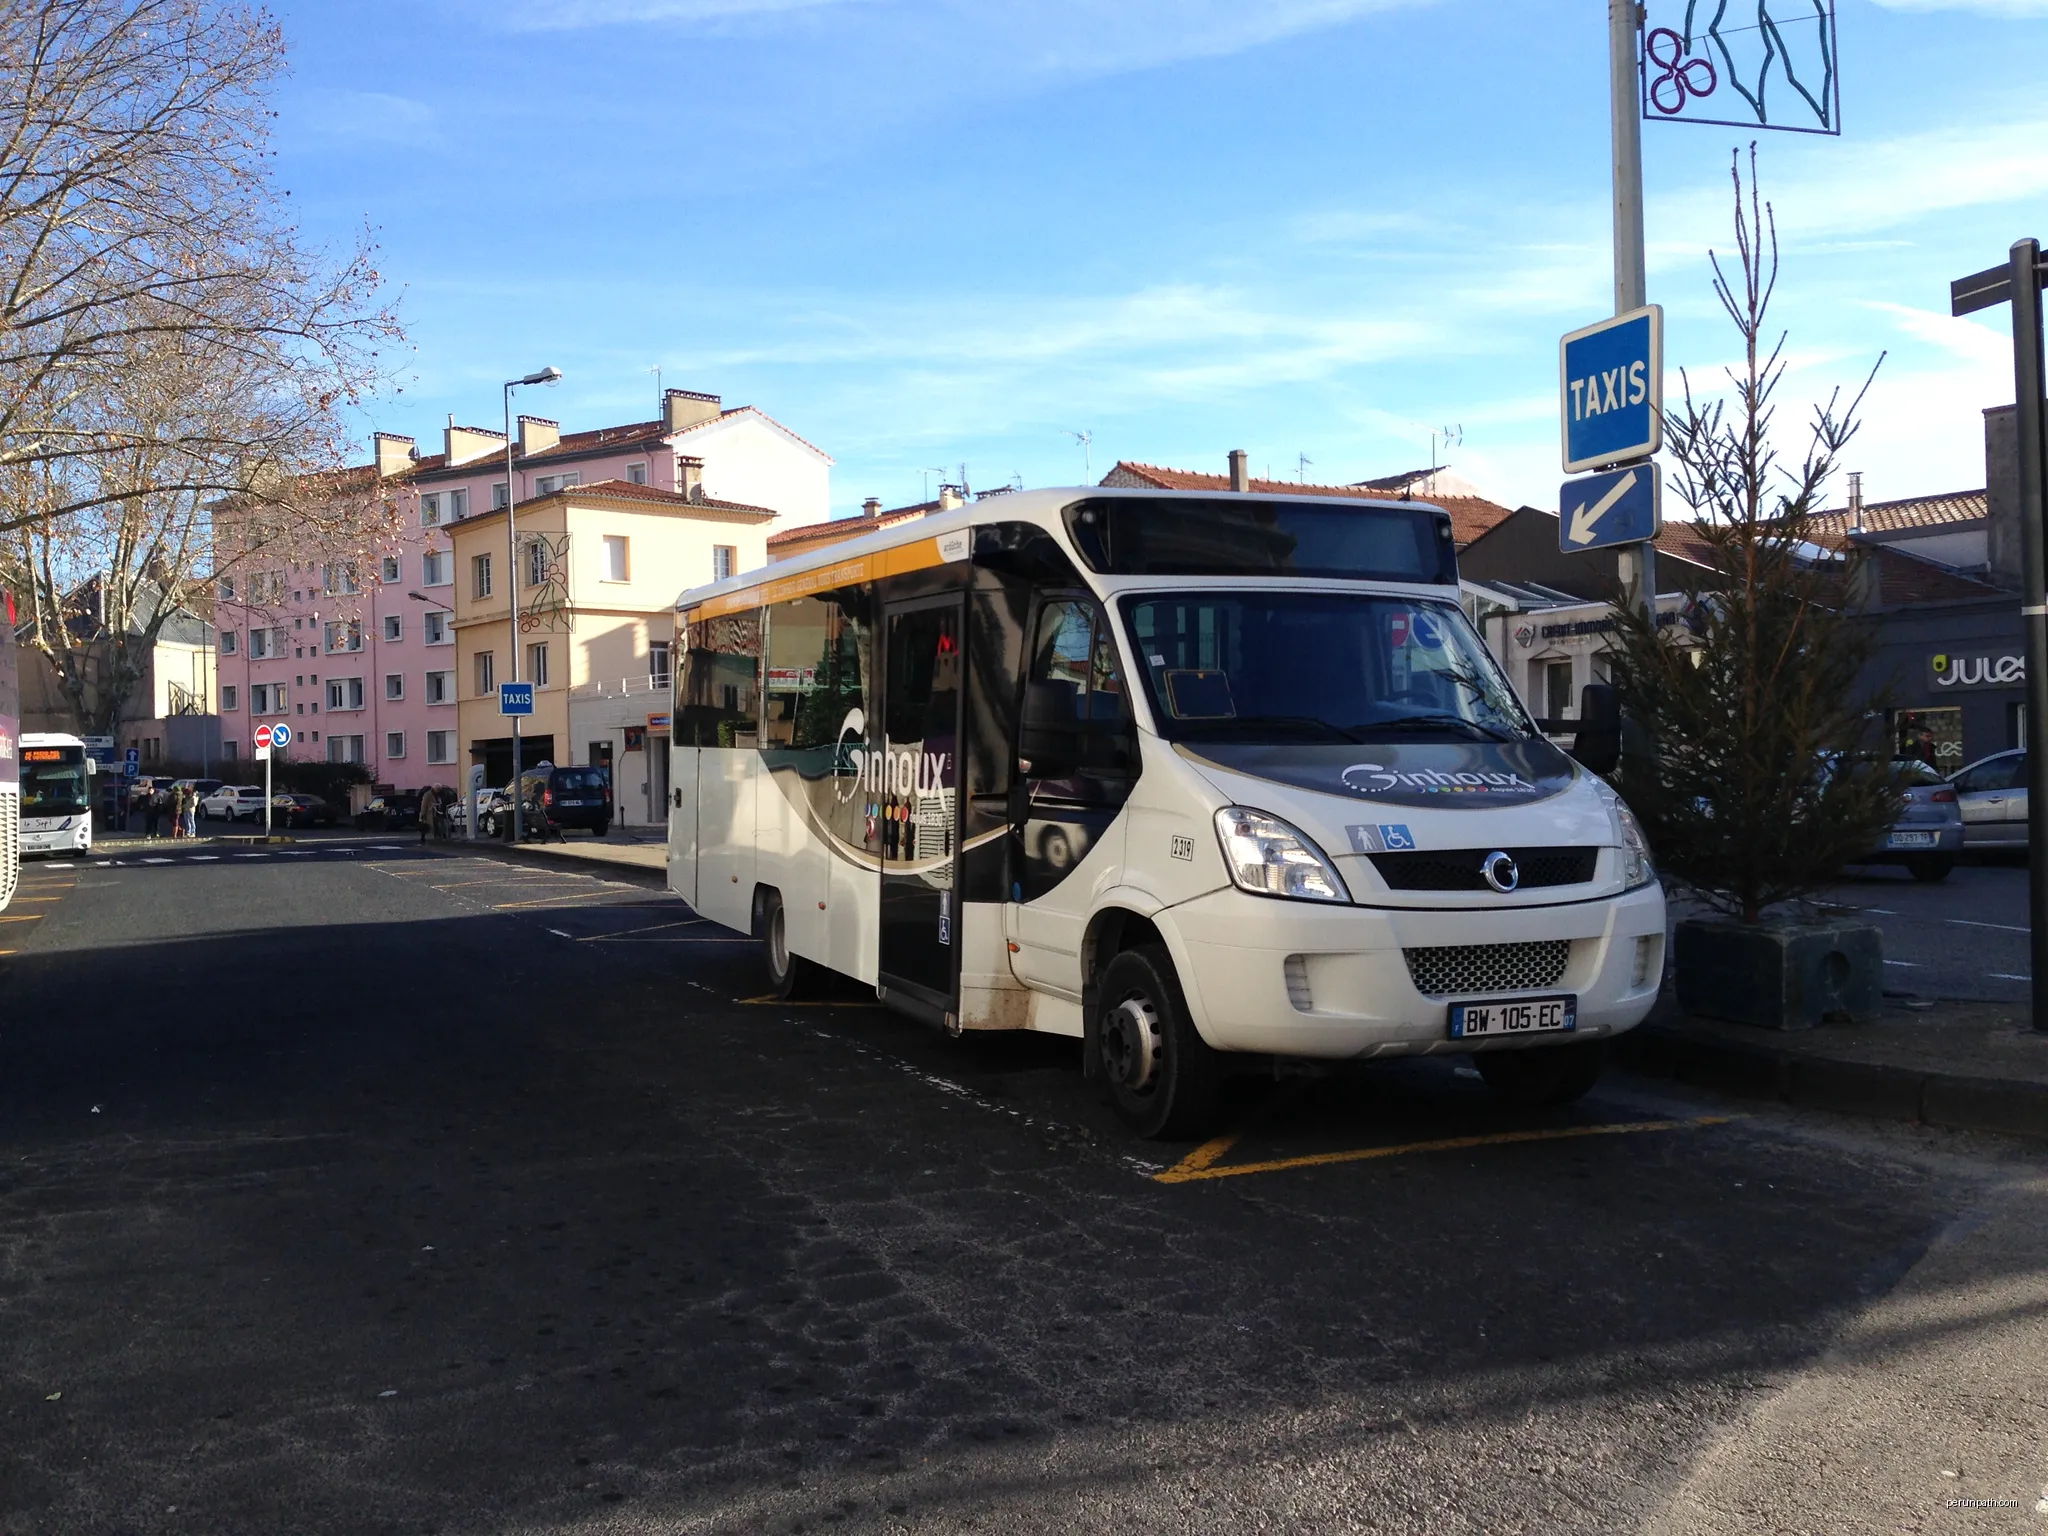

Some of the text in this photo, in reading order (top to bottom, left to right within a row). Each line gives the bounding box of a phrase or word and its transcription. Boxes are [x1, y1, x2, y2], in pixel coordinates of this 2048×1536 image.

[1570, 359, 1647, 422] TAXIS
[503, 693, 532, 705] TAXIS
[834, 707, 947, 812] Ginhoux
[1341, 763, 1536, 793] Ginhoux
[1173, 837, 1191, 858] 2319
[1564, 1014, 1575, 1027] 07
